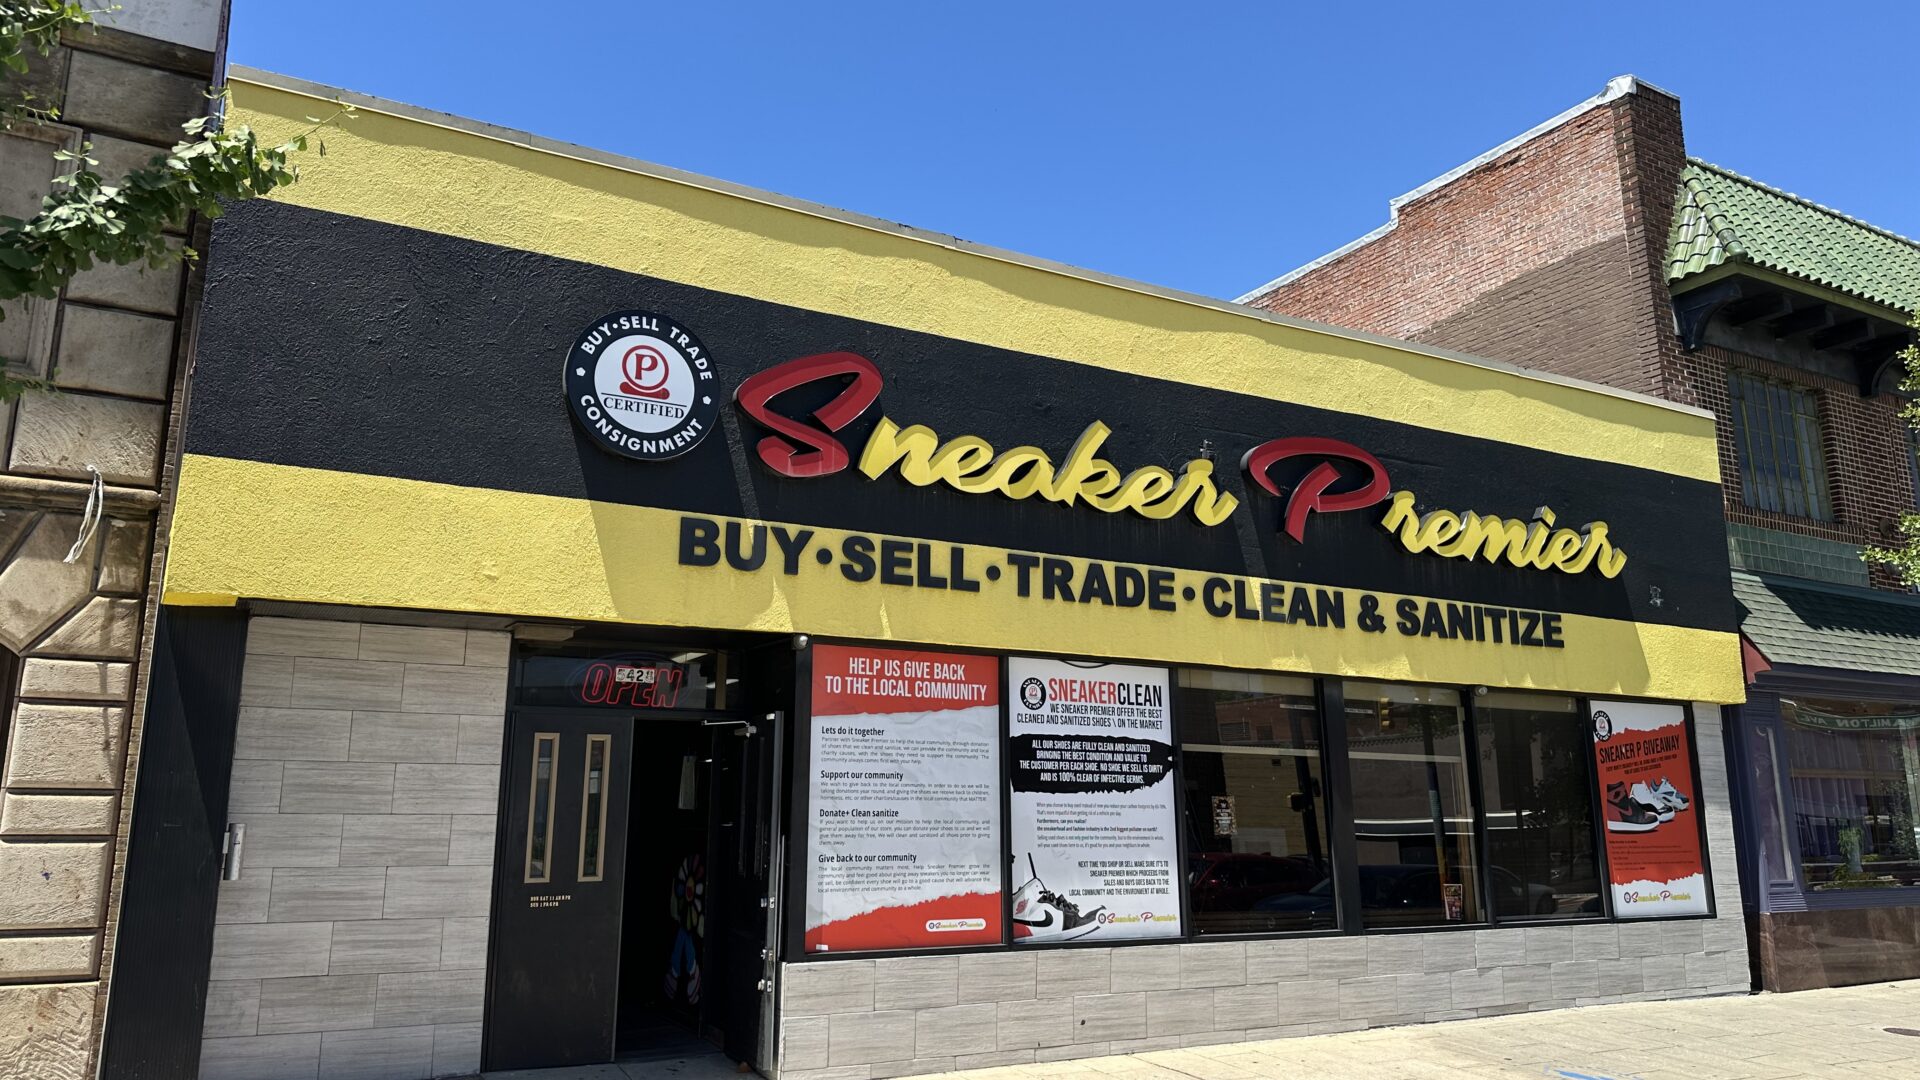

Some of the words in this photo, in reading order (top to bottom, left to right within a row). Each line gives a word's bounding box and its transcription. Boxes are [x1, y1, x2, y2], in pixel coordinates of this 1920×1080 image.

[580, 322, 612, 355] BUY
[620, 315, 660, 331] SELL
[669, 326, 713, 380] TRADE
[634, 353, 658, 380] P
[603, 397, 685, 419] CERTIFIED
[580, 394, 704, 454] CONSIGNMENT
[732, 350, 1240, 528] Sneaker
[1240, 436, 1628, 579] Premier
[1202, 578, 1345, 628] CLEAN
[1357, 593, 1387, 634] &
[1397, 598, 1565, 648] SANITIZE
[849, 657, 881, 676] HELP
[884, 660, 900, 677] US
[904, 661, 931, 679] GIVE
[934, 663, 965, 680] BACK
[582, 663, 682, 708] OPEN
[825, 676, 841, 694] TO
[845, 677, 869, 695] THE
[873, 678, 912, 697] LOCAL
[915, 681, 987, 701] COMMUNITY
[1048, 678, 1162, 707] SNEAKERCLEAN
[1017, 713, 1045, 724] CLEANED
[1046, 714, 1059, 725] AND
[1060, 715, 1090, 726] SANITIZED
[1092, 717, 1111, 728] SHOES
[1118, 718, 1125, 728] ON
[1127, 719, 1138, 729] THE
[1139, 720, 1163, 730] MARKET
[1050, 703, 1059, 713] WE
[1061, 704, 1088, 715] SNEAKER
[1090, 706, 1115, 716] PREMIER
[1117, 707, 1135, 717] OFFER
[1136, 708, 1147, 718] THE
[1148, 708, 1162, 719] BEST
[821, 726, 836, 735] Lets
[838, 726, 846, 735] do
[848, 726, 854, 735] it
[855, 727, 884, 737] together
[1032, 739, 1042, 748] ALL
[1042, 740, 1054, 749] OUR
[1054, 740, 1071, 749] SHOES
[1072, 741, 1082, 750] ARE
[1083, 741, 1098, 751] FULLY
[1098, 742, 1114, 751] CLEAN
[1115, 743, 1125, 752] AND
[1126, 744, 1151, 752] SANITIZED
[1036, 750, 1061, 760] BRINGING
[1062, 751, 1072, 760] THE
[1072, 751, 1085, 760] BEST
[1086, 752, 1113, 761] CONDITION
[1113, 752, 1124, 762] AND
[1124, 753, 1140, 762] VALUE
[1140, 754, 1147, 762] TO
[1599, 742, 1635, 764] SNEAKER
[1636, 741, 1642, 757] P
[1643, 734, 1680, 756] GIVEAWAY
[821, 770, 849, 780] Support
[864, 771, 904, 782] community
[1019, 760, 1030, 769] THE
[1030, 760, 1059, 770] CUSTOMER
[1059, 761, 1070, 770] PER
[1070, 762, 1084, 770] EACH
[1108, 763, 1121, 772] SHOE
[1122, 763, 1130, 772] WE
[1130, 764, 1142, 772] SELL
[1143, 764, 1148, 773] IS
[1149, 765, 1163, 773] DIRTY
[1040, 772, 1052, 781] AND
[1052, 772, 1058, 781] IS
[1058, 772, 1075, 782] 100%
[1076, 773, 1093, 782] CLEAR
[1094, 774, 1100, 783] OF
[820, 808, 850, 817] Donate+
[851, 808, 871, 817] Clean
[872, 808, 899, 817] sanitize
[818, 854, 835, 863] Give
[836, 853, 854, 862] back
[855, 854, 862, 862] to
[878, 853, 917, 864] community
